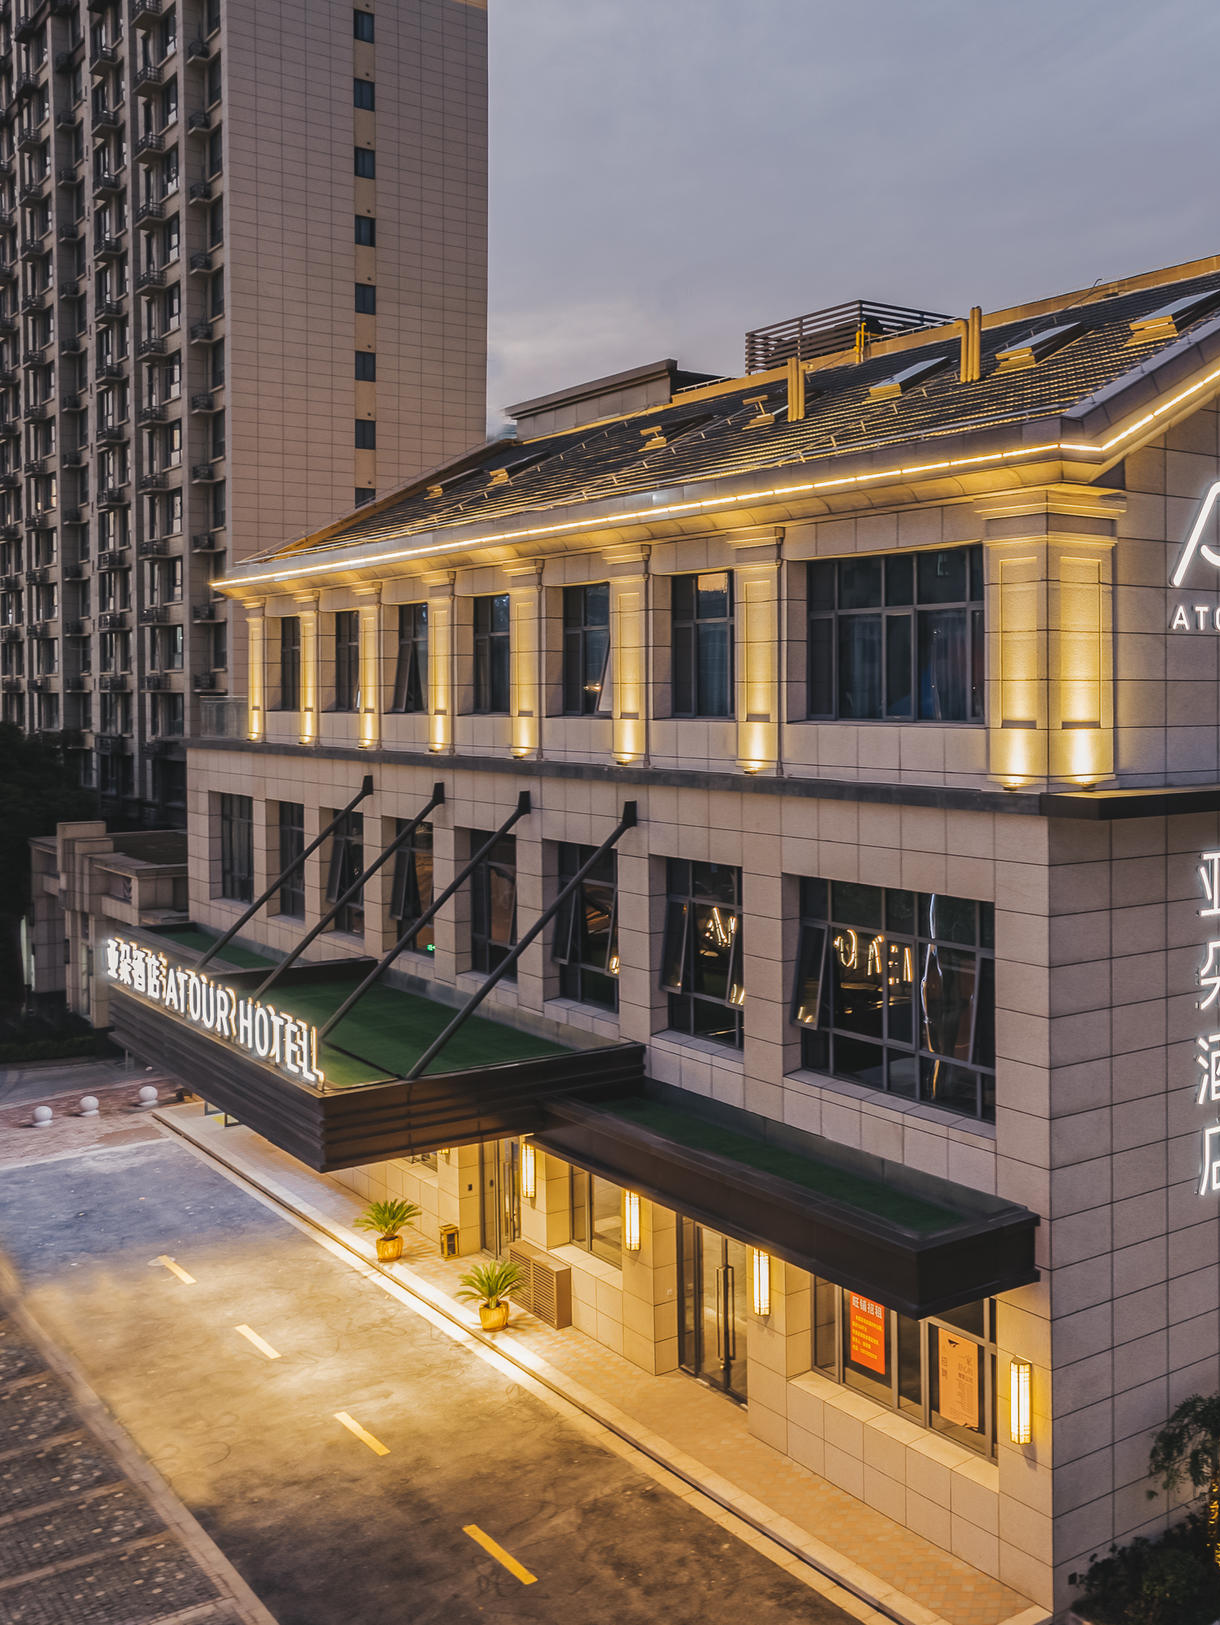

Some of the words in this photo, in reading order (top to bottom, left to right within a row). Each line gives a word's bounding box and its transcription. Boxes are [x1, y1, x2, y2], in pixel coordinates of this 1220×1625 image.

[106, 937, 163, 1000] 亚朵酒店
[165, 967, 233, 1038] ATOUR
[239, 998, 321, 1083] HOTEL
